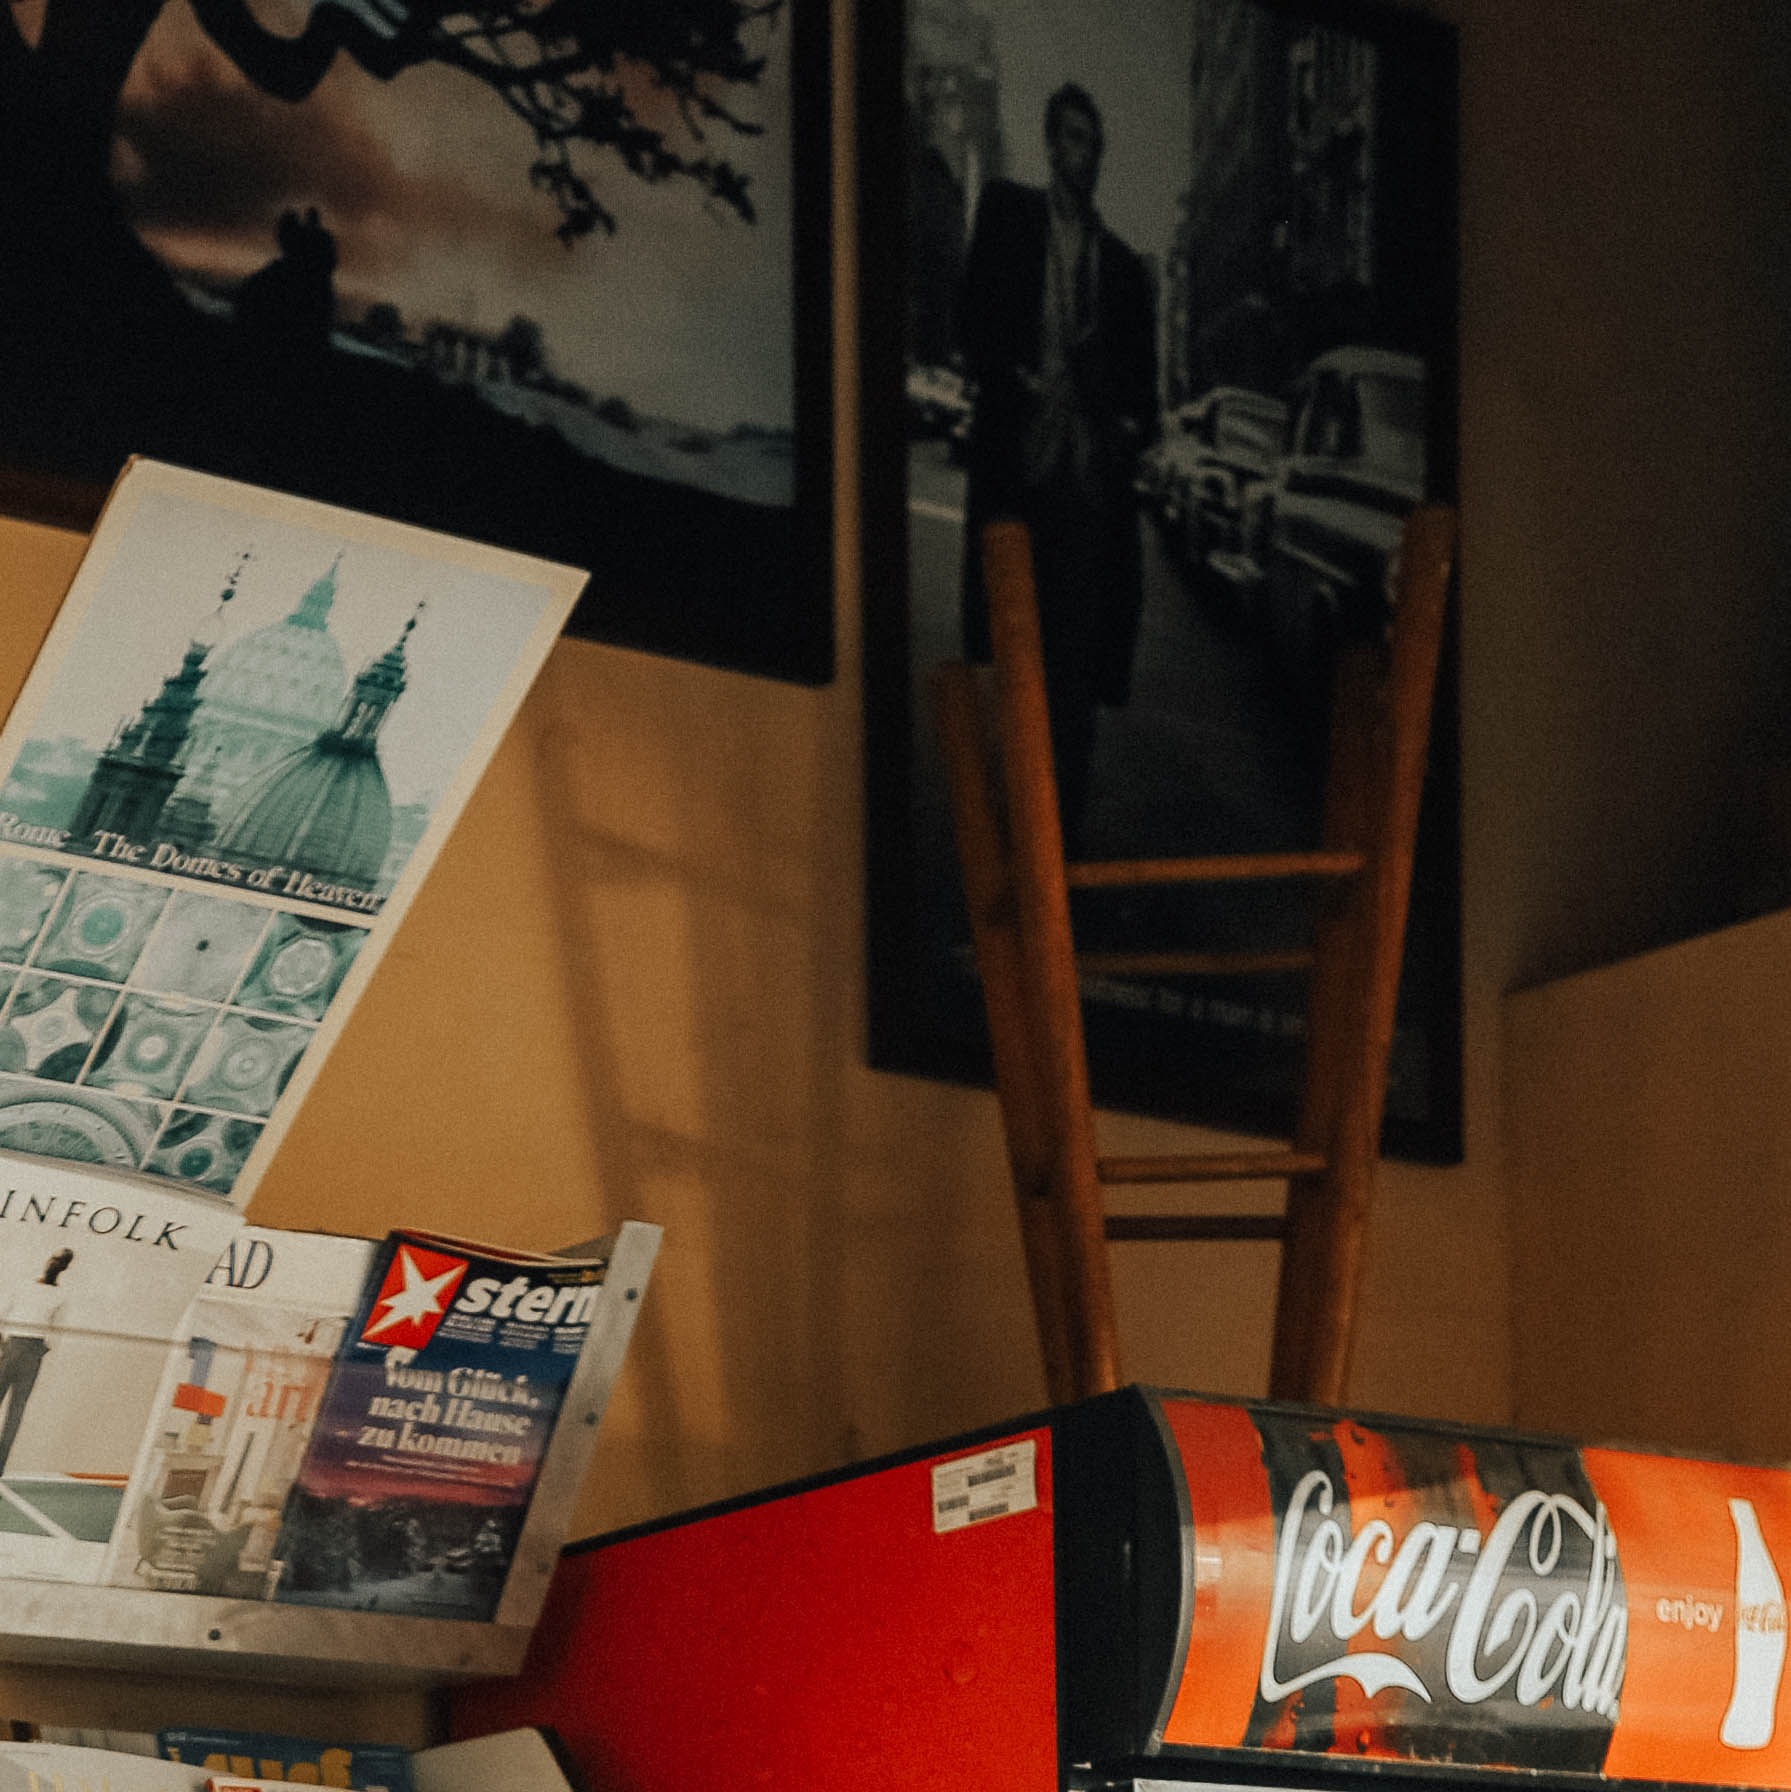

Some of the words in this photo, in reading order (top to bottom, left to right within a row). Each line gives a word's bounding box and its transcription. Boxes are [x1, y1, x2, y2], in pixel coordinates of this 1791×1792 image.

[94, 830, 147, 862] The
[150, 844, 242, 882] Domes
[247, 866, 285, 889] of
[282, 871, 386, 911] Heaven
[206, 1237, 274, 1291] AD
[455, 1276, 603, 1324] stern
[369, 1394, 441, 1424] nach
[443, 1399, 532, 1436] Hause
[358, 1426, 396, 1448] zu
[397, 1421, 523, 1464] kommen
[1261, 1470, 1627, 1718] Coca-Cola
[1656, 1596, 1723, 1633] enjoy
